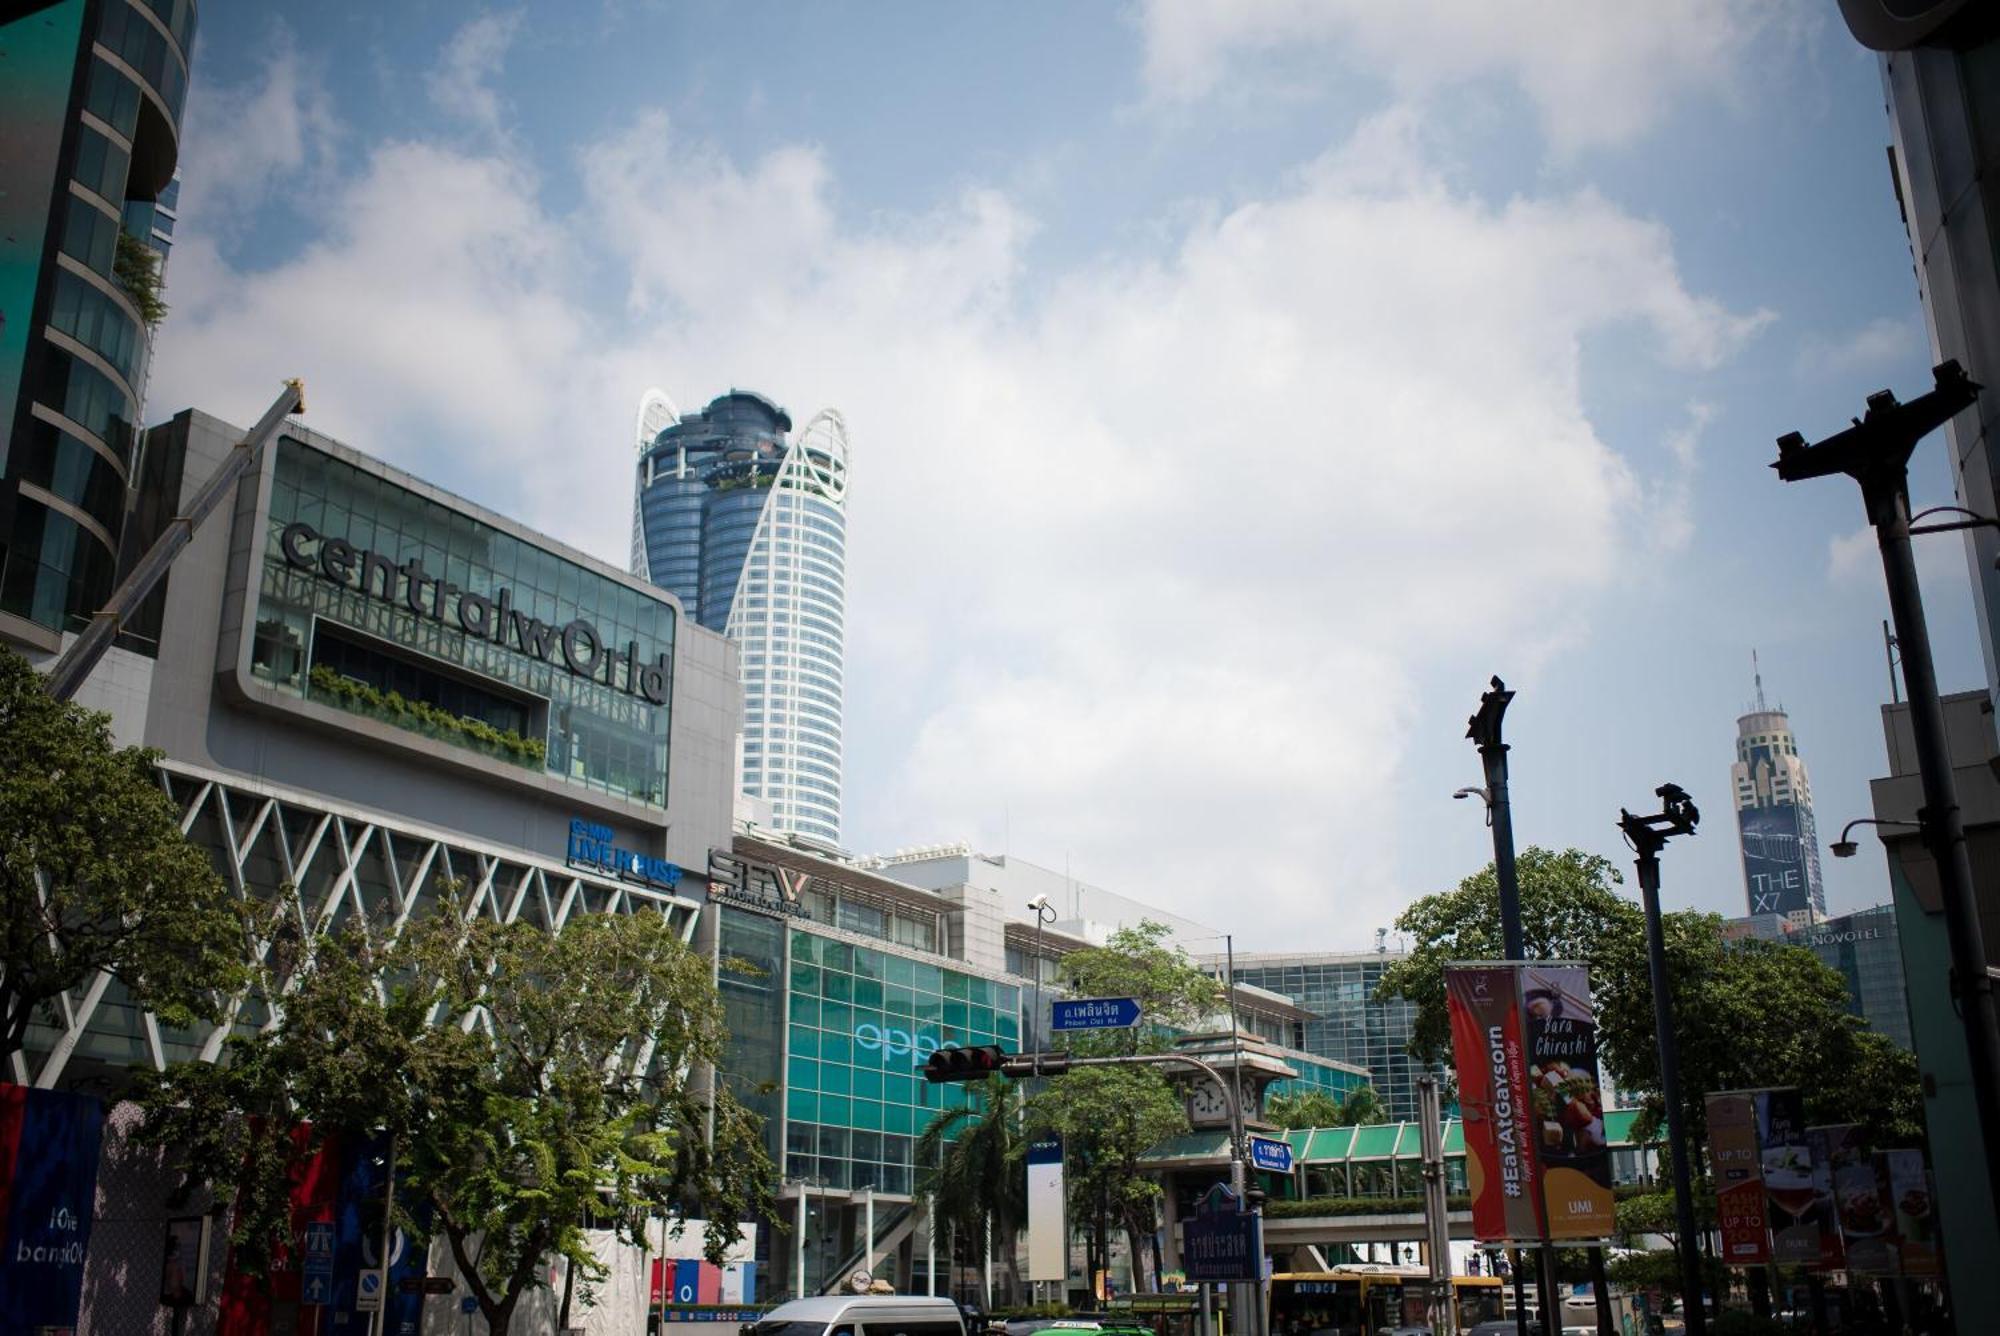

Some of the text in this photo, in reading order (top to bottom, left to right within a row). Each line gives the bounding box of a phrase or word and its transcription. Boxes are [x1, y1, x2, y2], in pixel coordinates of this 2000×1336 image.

[281, 523, 669, 705] centralwOrld
[570, 834, 612, 867] LIVE
[1752, 869, 1801, 892] THE
[1754, 892, 1781, 912] X7
[1812, 928, 1882, 946] NOVOTEL
[1536, 1036, 1587, 1057] Chirashi
[1488, 1025, 1521, 1198] #EatAtGaysorn
[1568, 1200, 1592, 1214] UMI
[1723, 1215, 1761, 1229] UP TO
